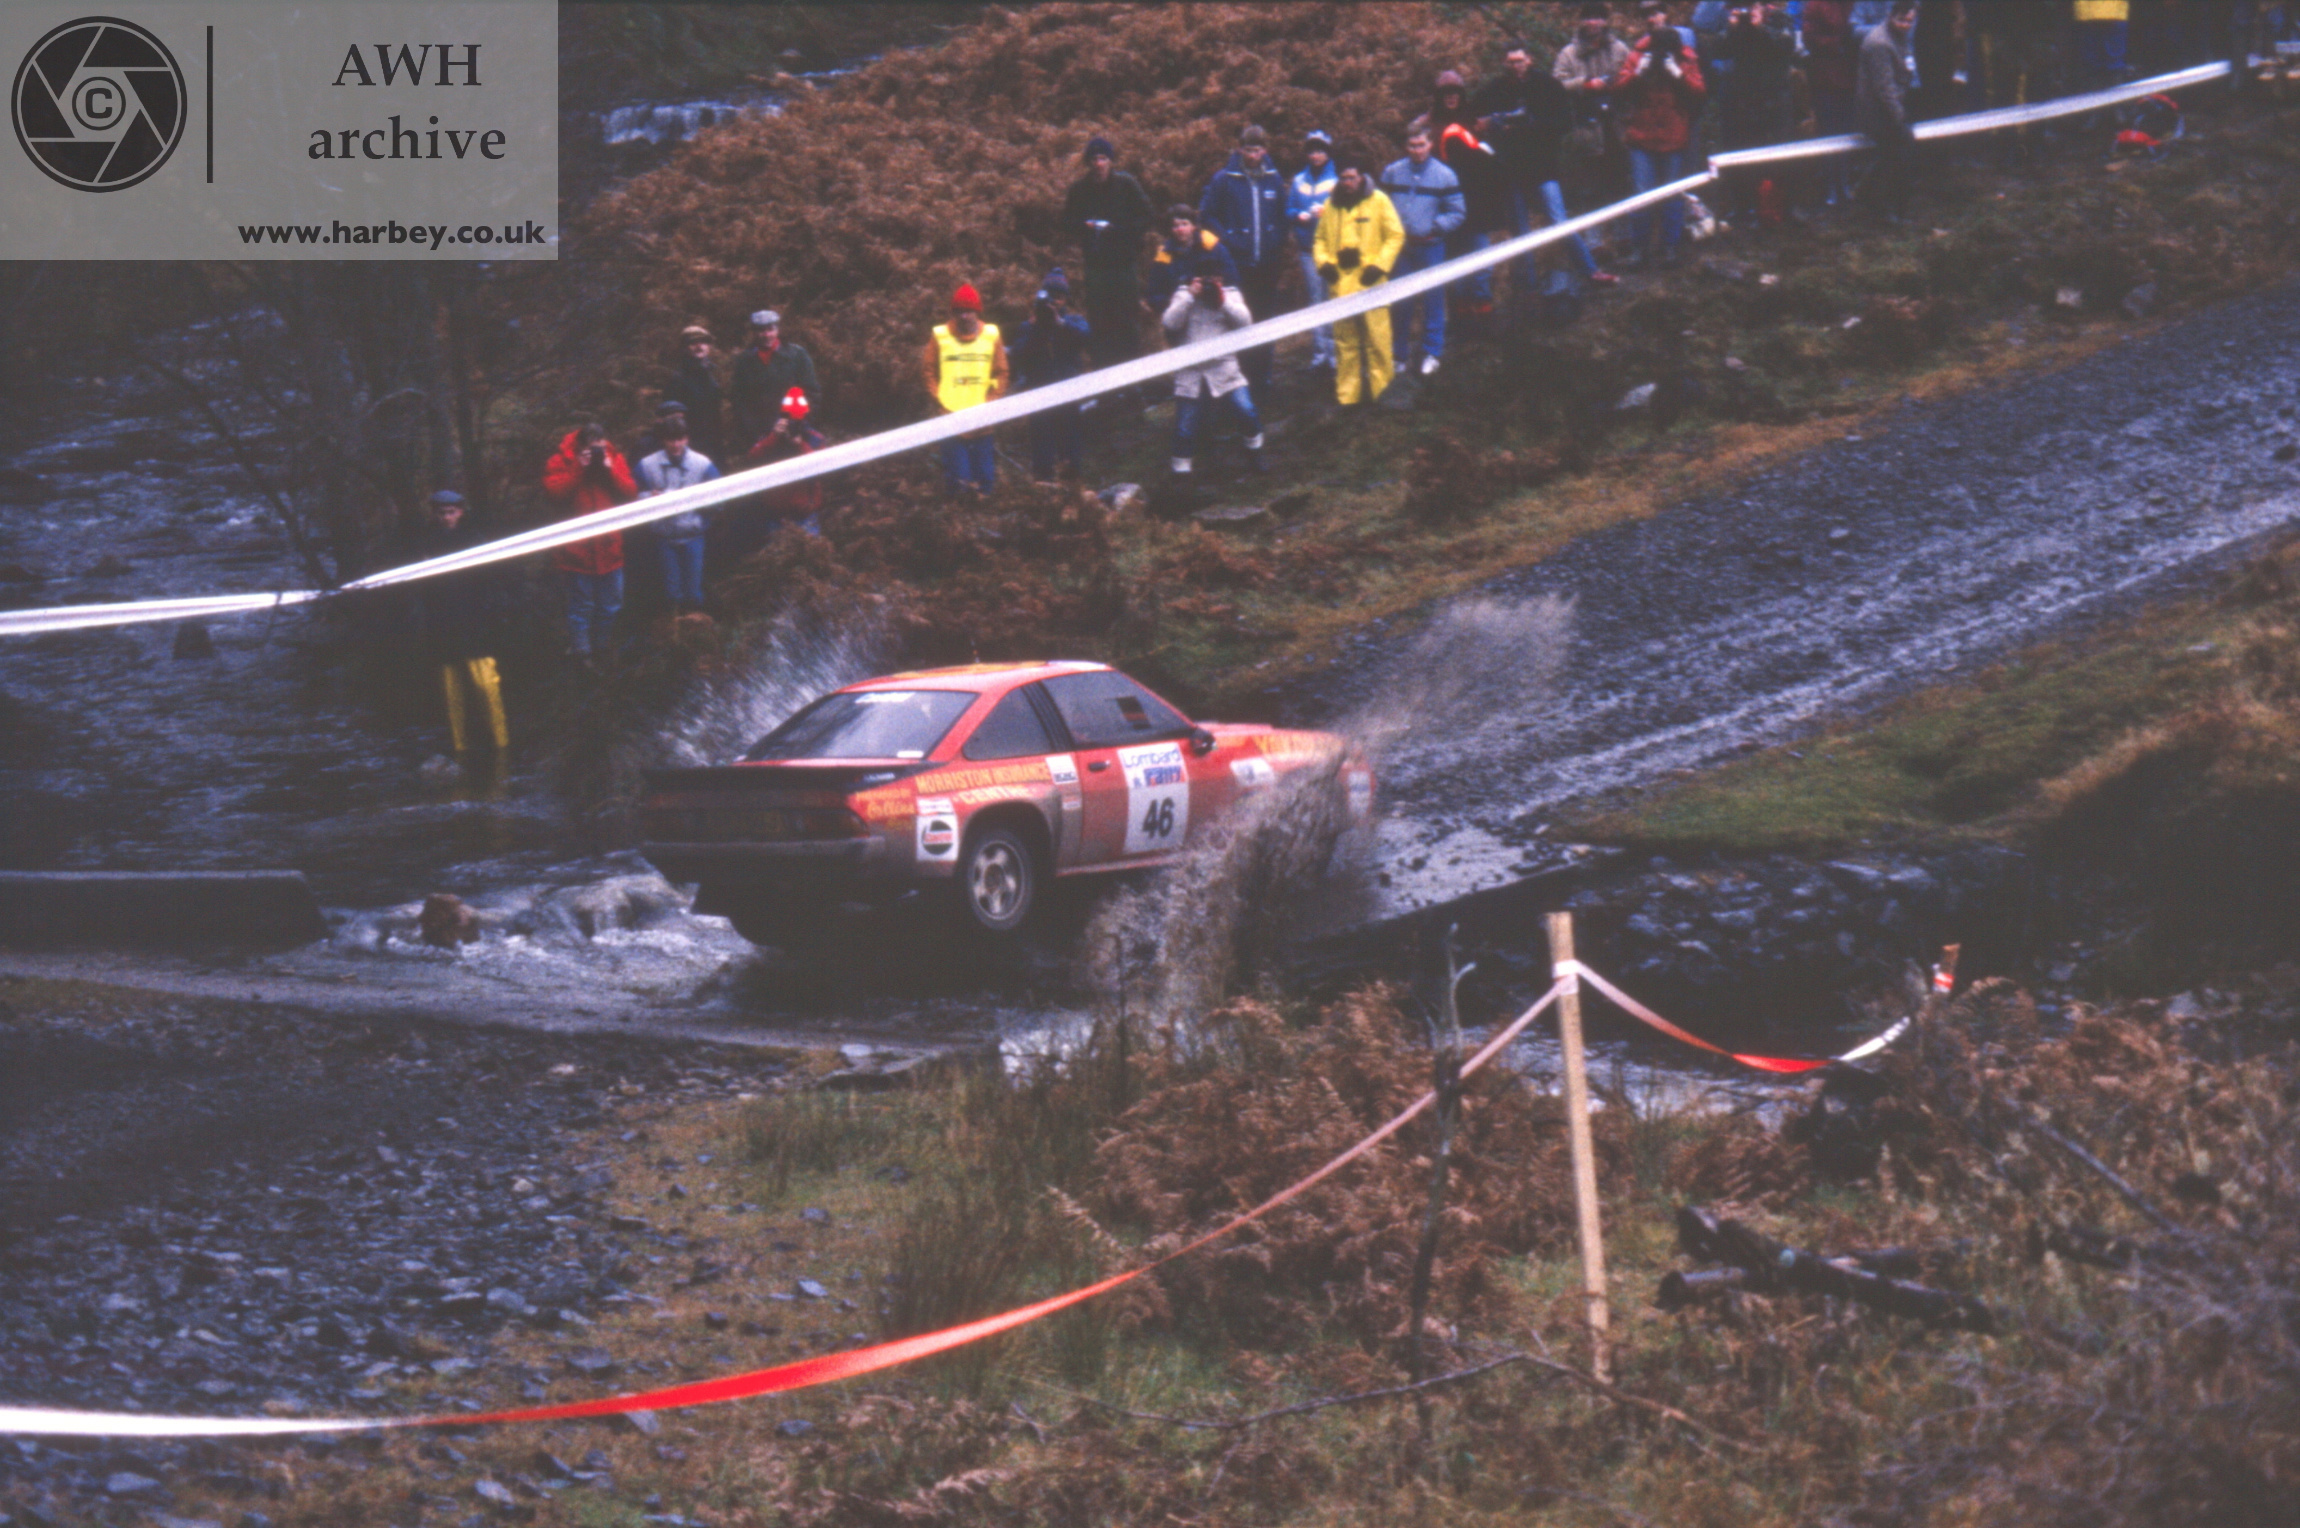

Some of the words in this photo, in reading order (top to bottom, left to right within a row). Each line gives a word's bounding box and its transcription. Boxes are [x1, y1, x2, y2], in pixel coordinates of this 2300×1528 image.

[1121, 749, 1180, 768] Lombard
[915, 768, 994, 794] MORRISTON
[1142, 797, 1175, 839] 46
